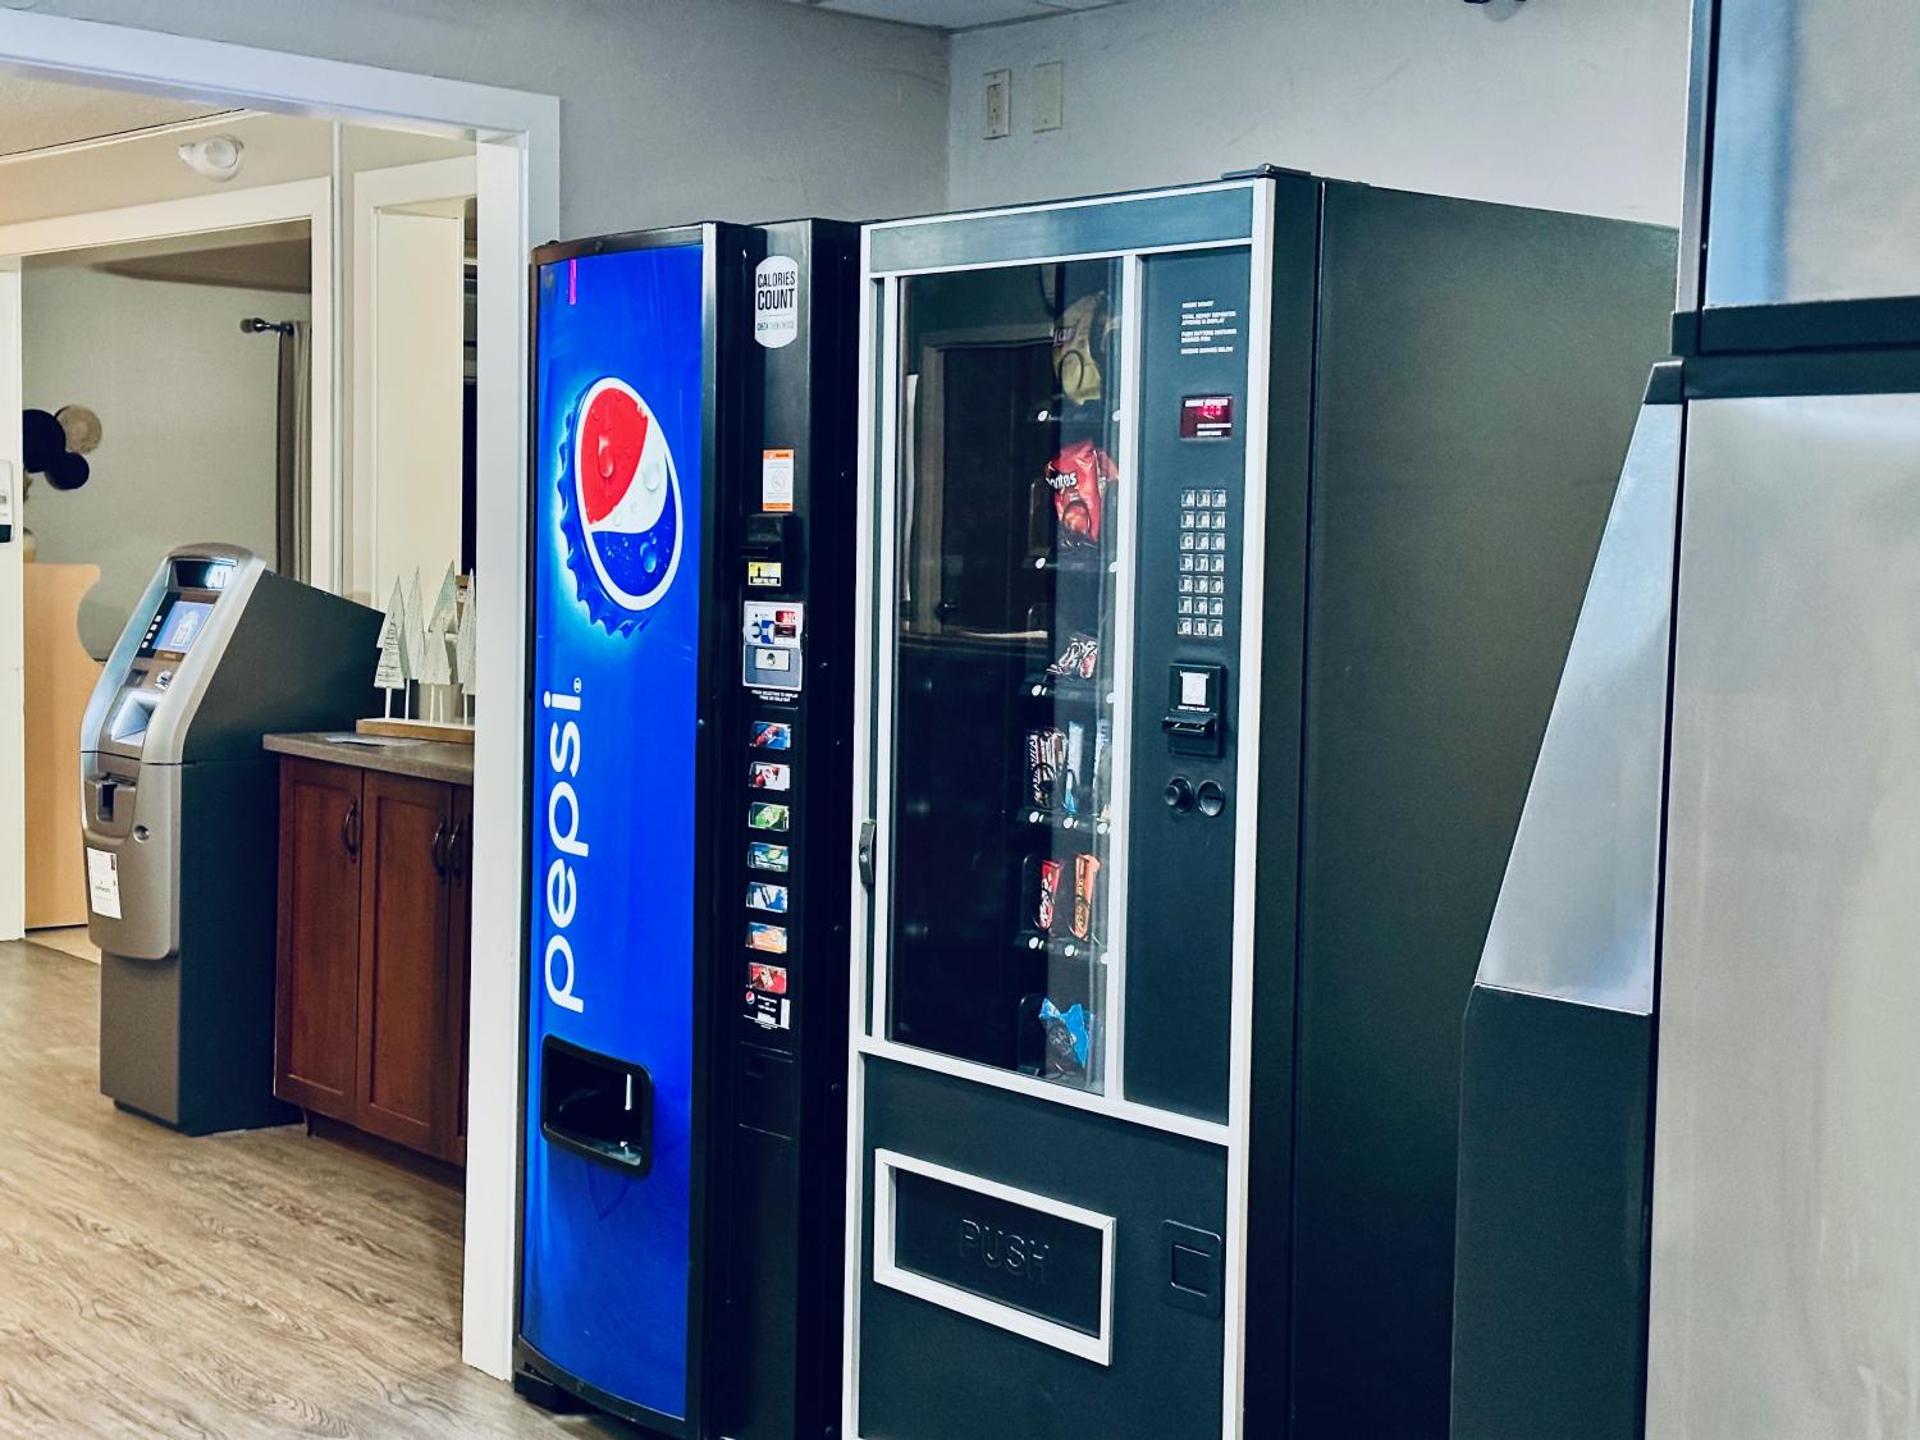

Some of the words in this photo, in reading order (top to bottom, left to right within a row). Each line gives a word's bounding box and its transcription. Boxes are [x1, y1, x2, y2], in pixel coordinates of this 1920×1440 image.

[757, 271, 796, 288] CALORIES
[757, 288, 796, 310] COUNT
[543, 690, 589, 1014] pepsi
[958, 1218, 1050, 1286] PUSH
